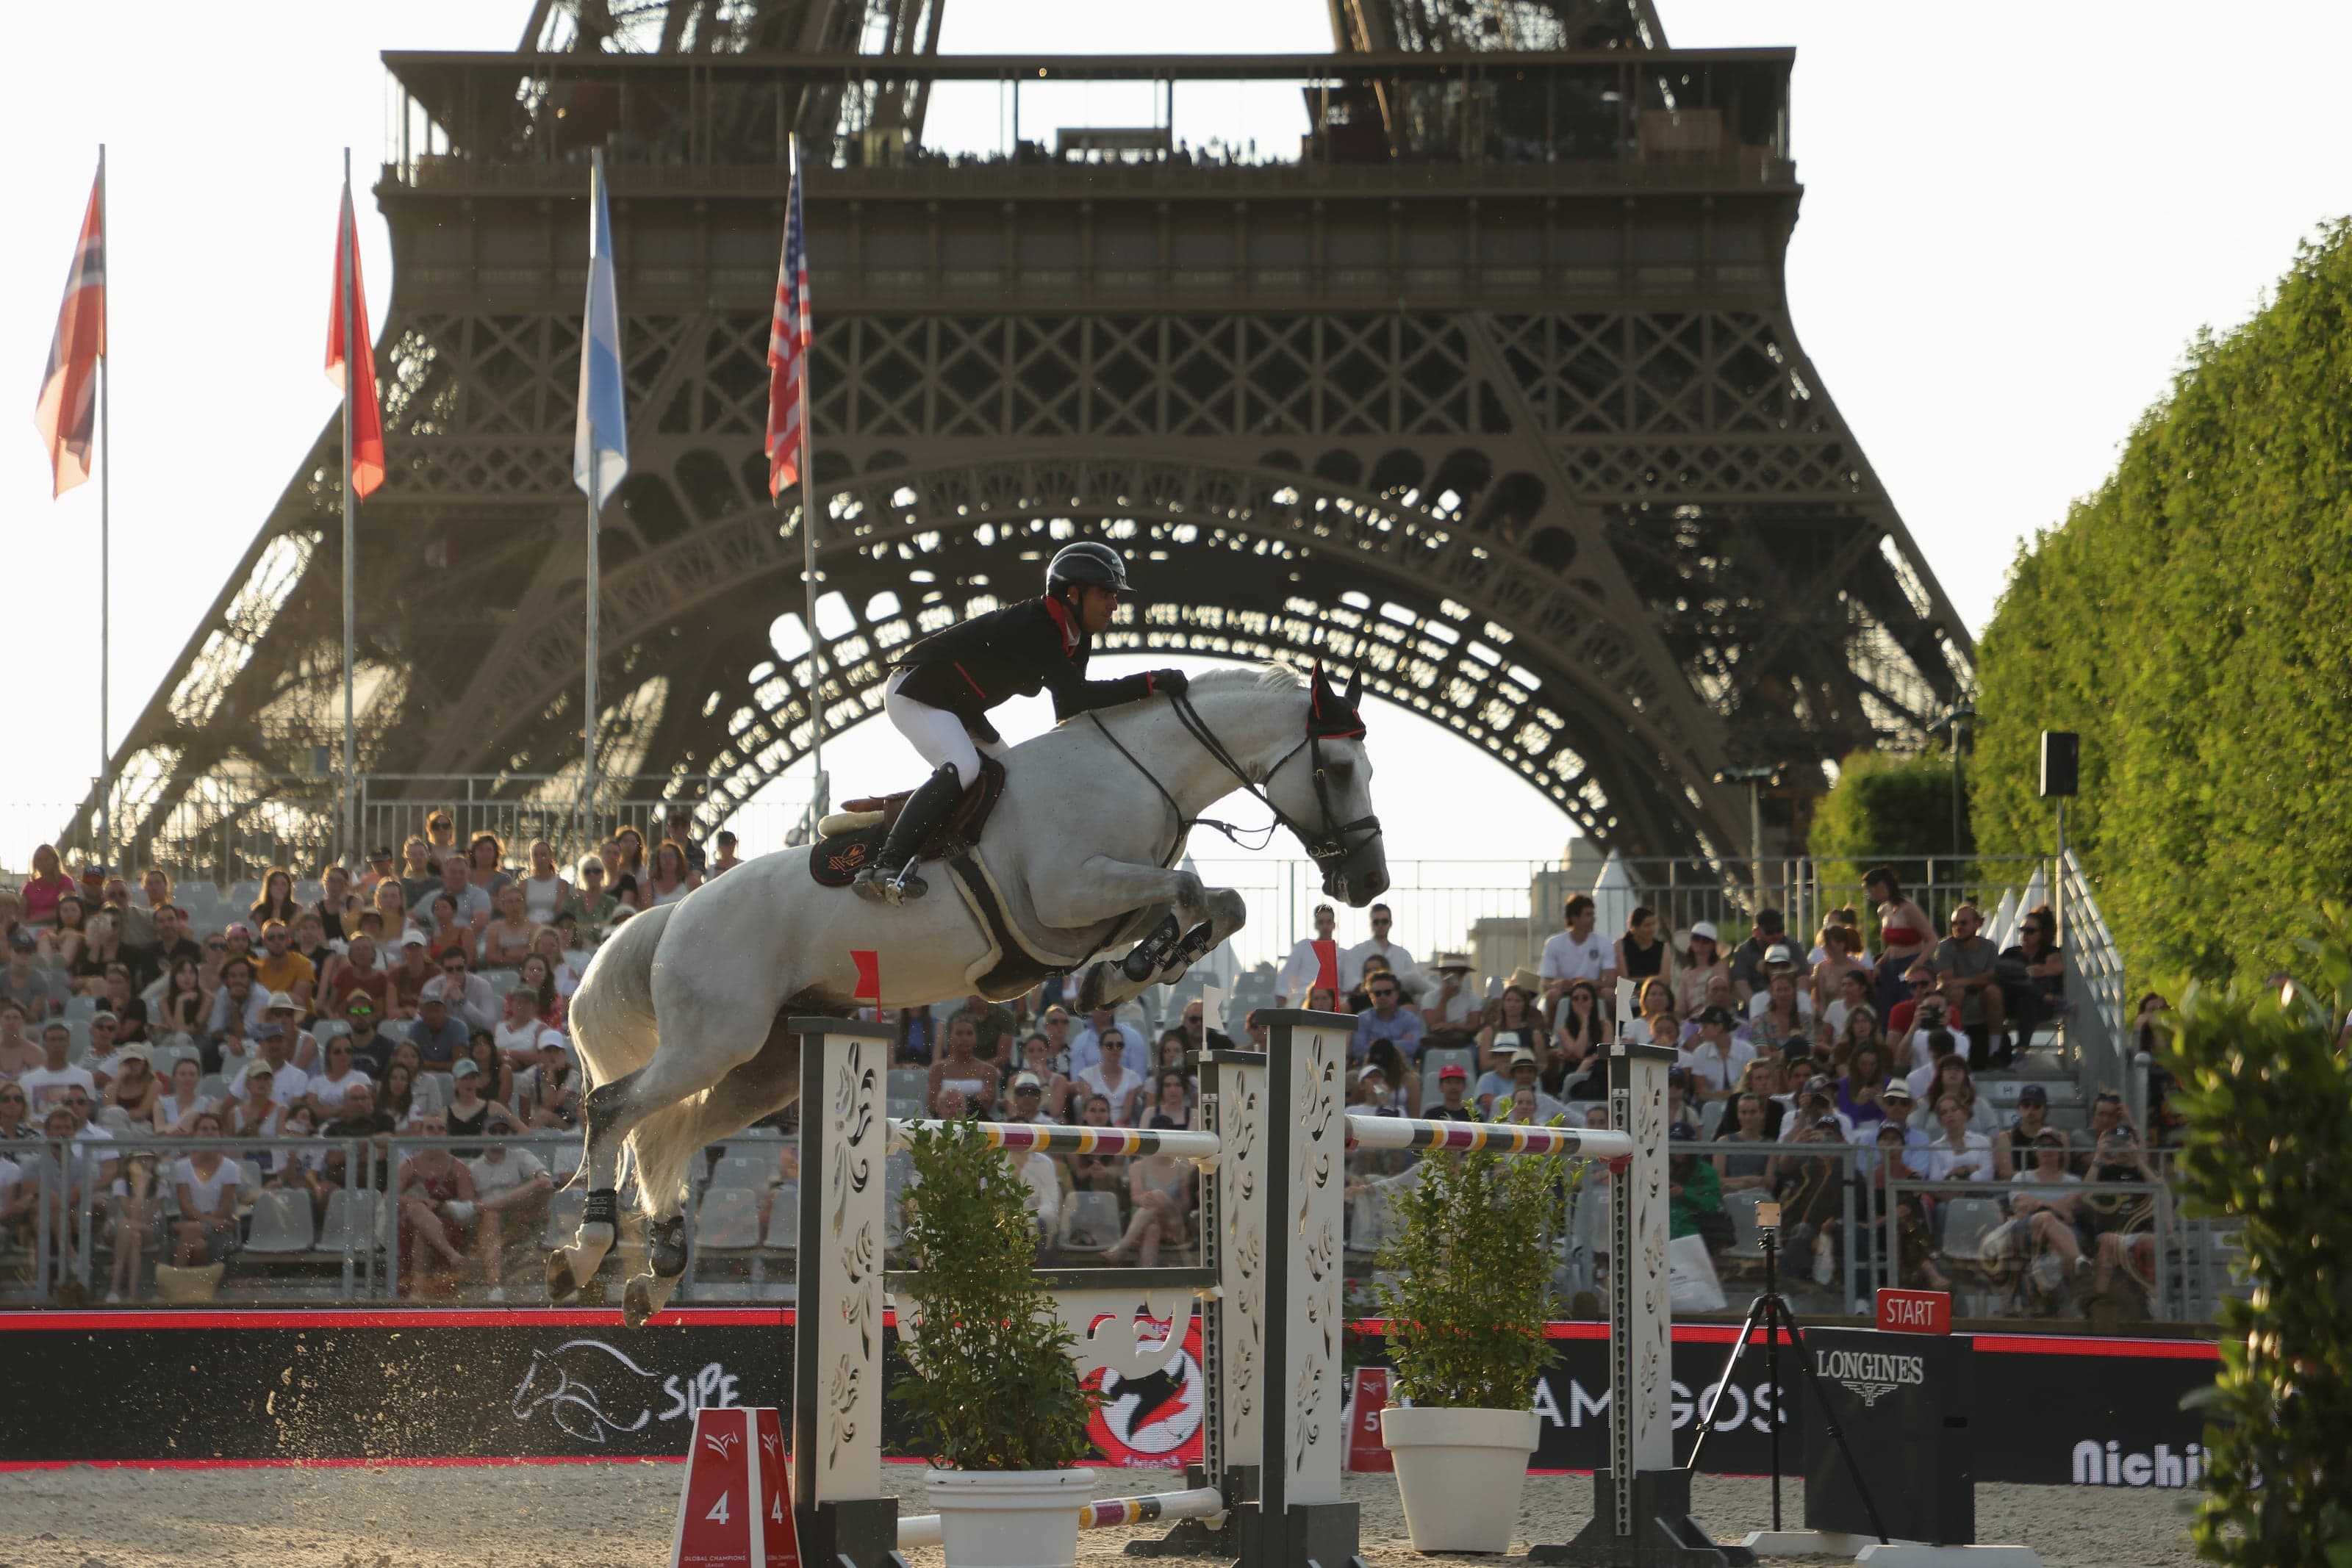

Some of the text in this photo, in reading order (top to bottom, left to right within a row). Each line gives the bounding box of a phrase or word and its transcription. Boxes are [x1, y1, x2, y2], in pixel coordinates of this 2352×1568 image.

[1886, 1298, 1935, 1326] START
[1816, 1350, 1924, 1384] LONGINES
[1364, 1411, 1379, 1432] 5
[1532, 1376, 1787, 1433] AMGOS
[706, 1489, 730, 1525] 4
[770, 1489, 784, 1525] 4
